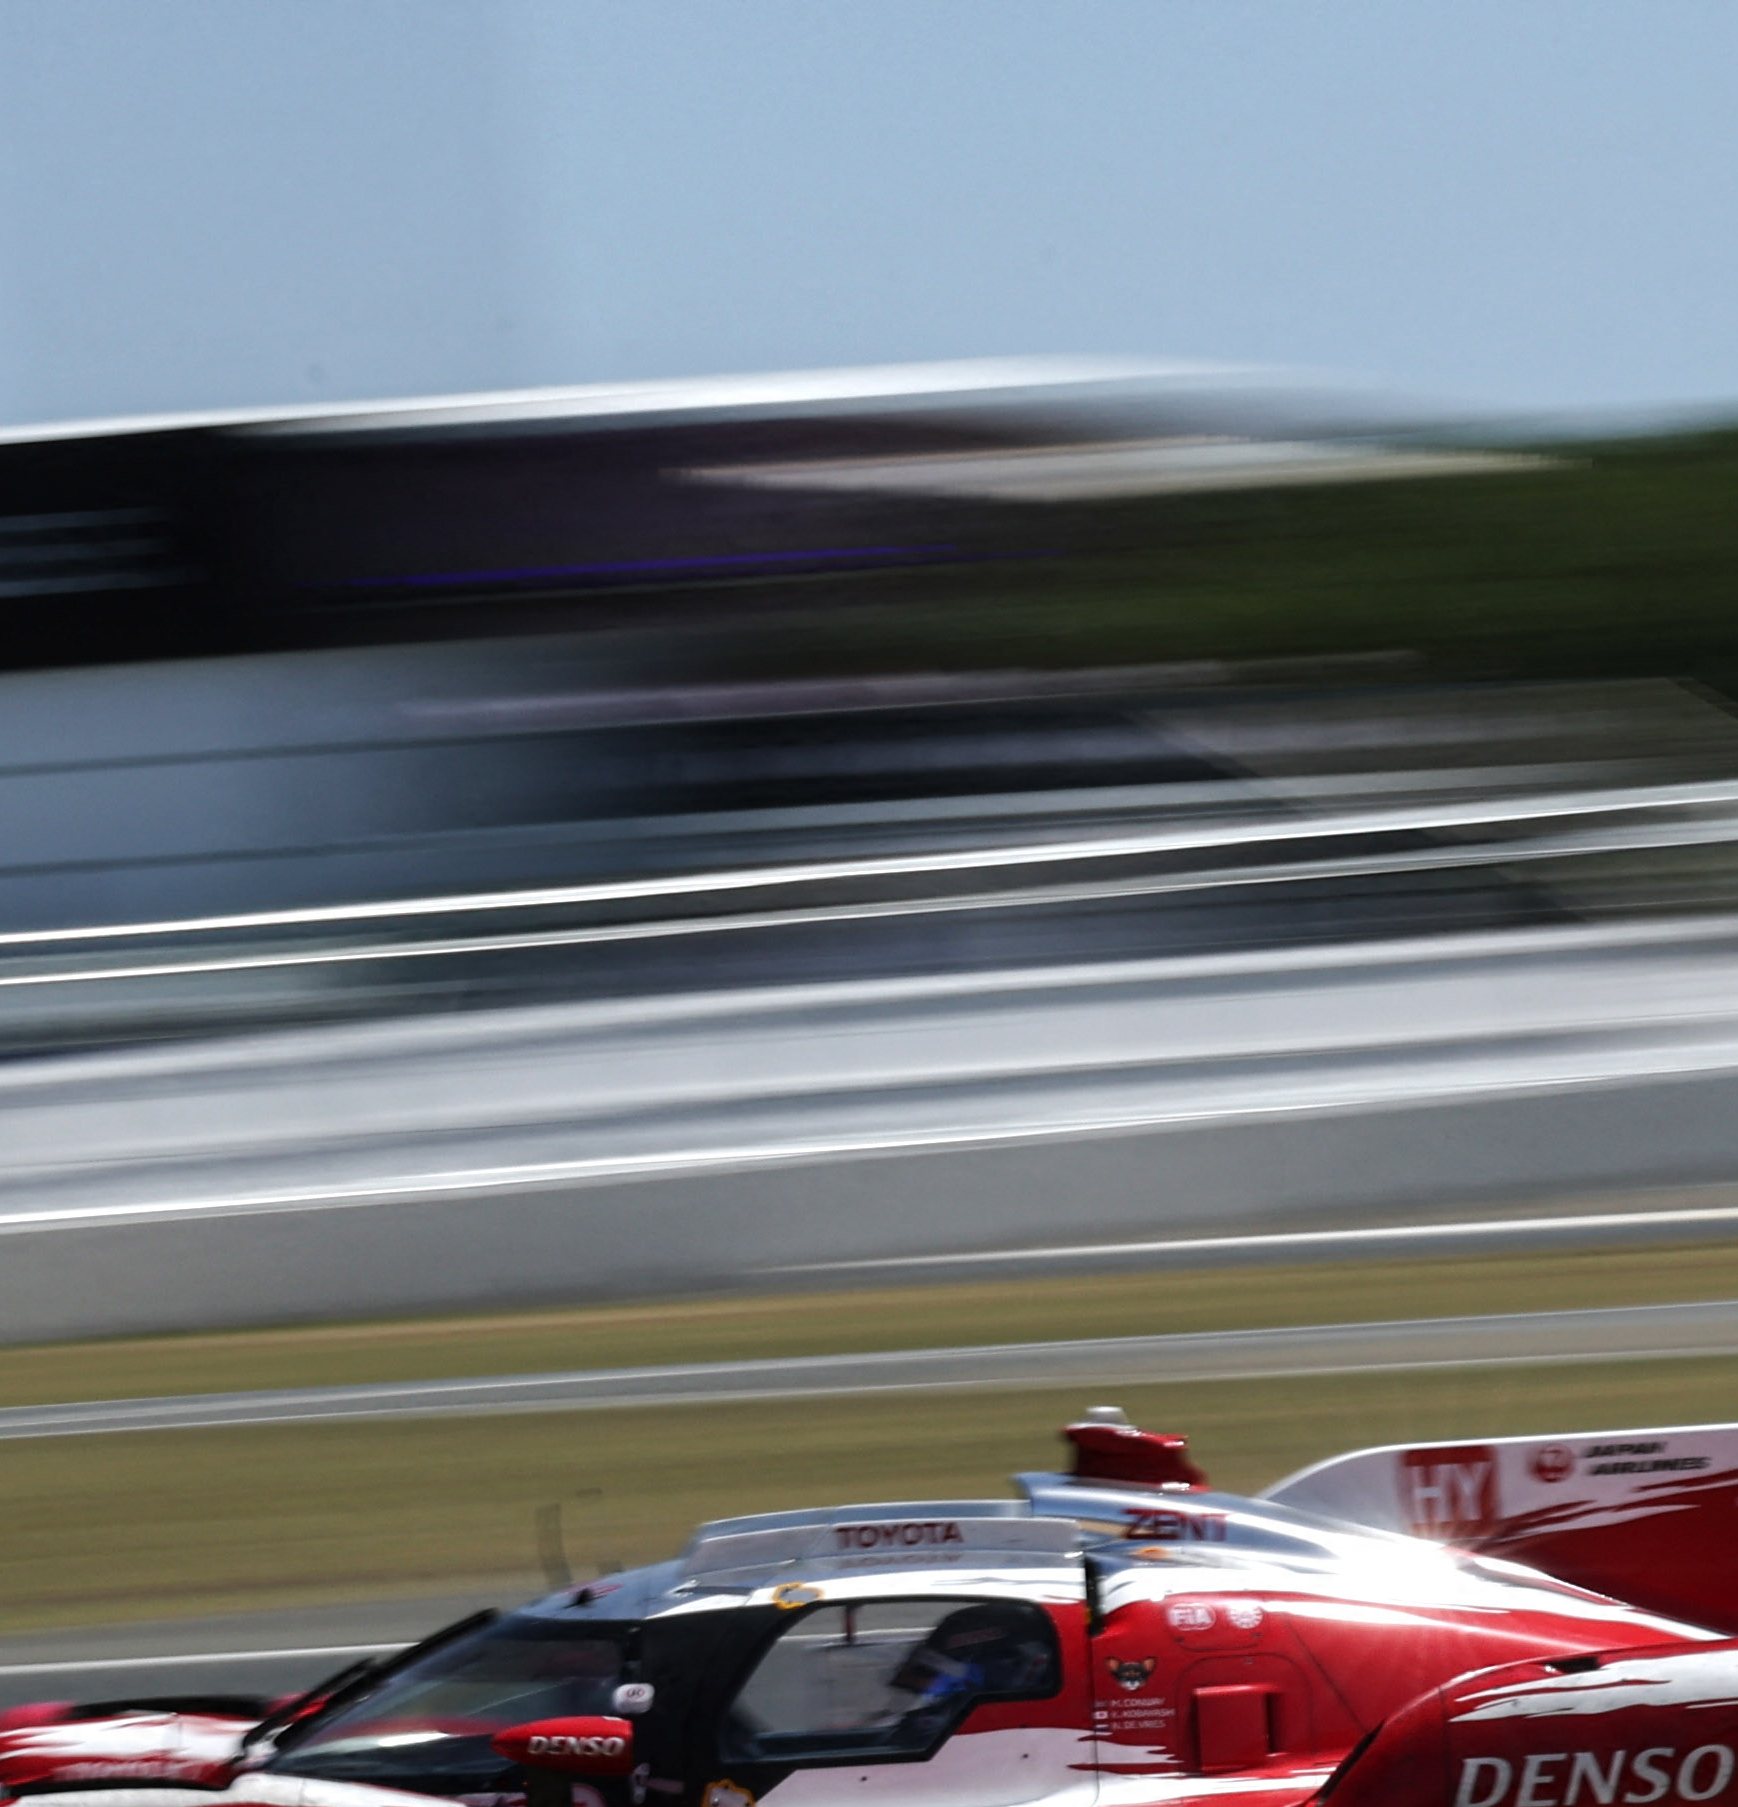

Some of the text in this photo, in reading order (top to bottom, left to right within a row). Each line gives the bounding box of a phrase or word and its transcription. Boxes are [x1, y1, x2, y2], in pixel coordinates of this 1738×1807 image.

[1414, 1460, 1492, 1524] HY
[834, 1521, 964, 1549] TOYOTA
[1119, 1507, 1230, 1542] ZENT
[527, 1735, 626, 1756] DENSO
